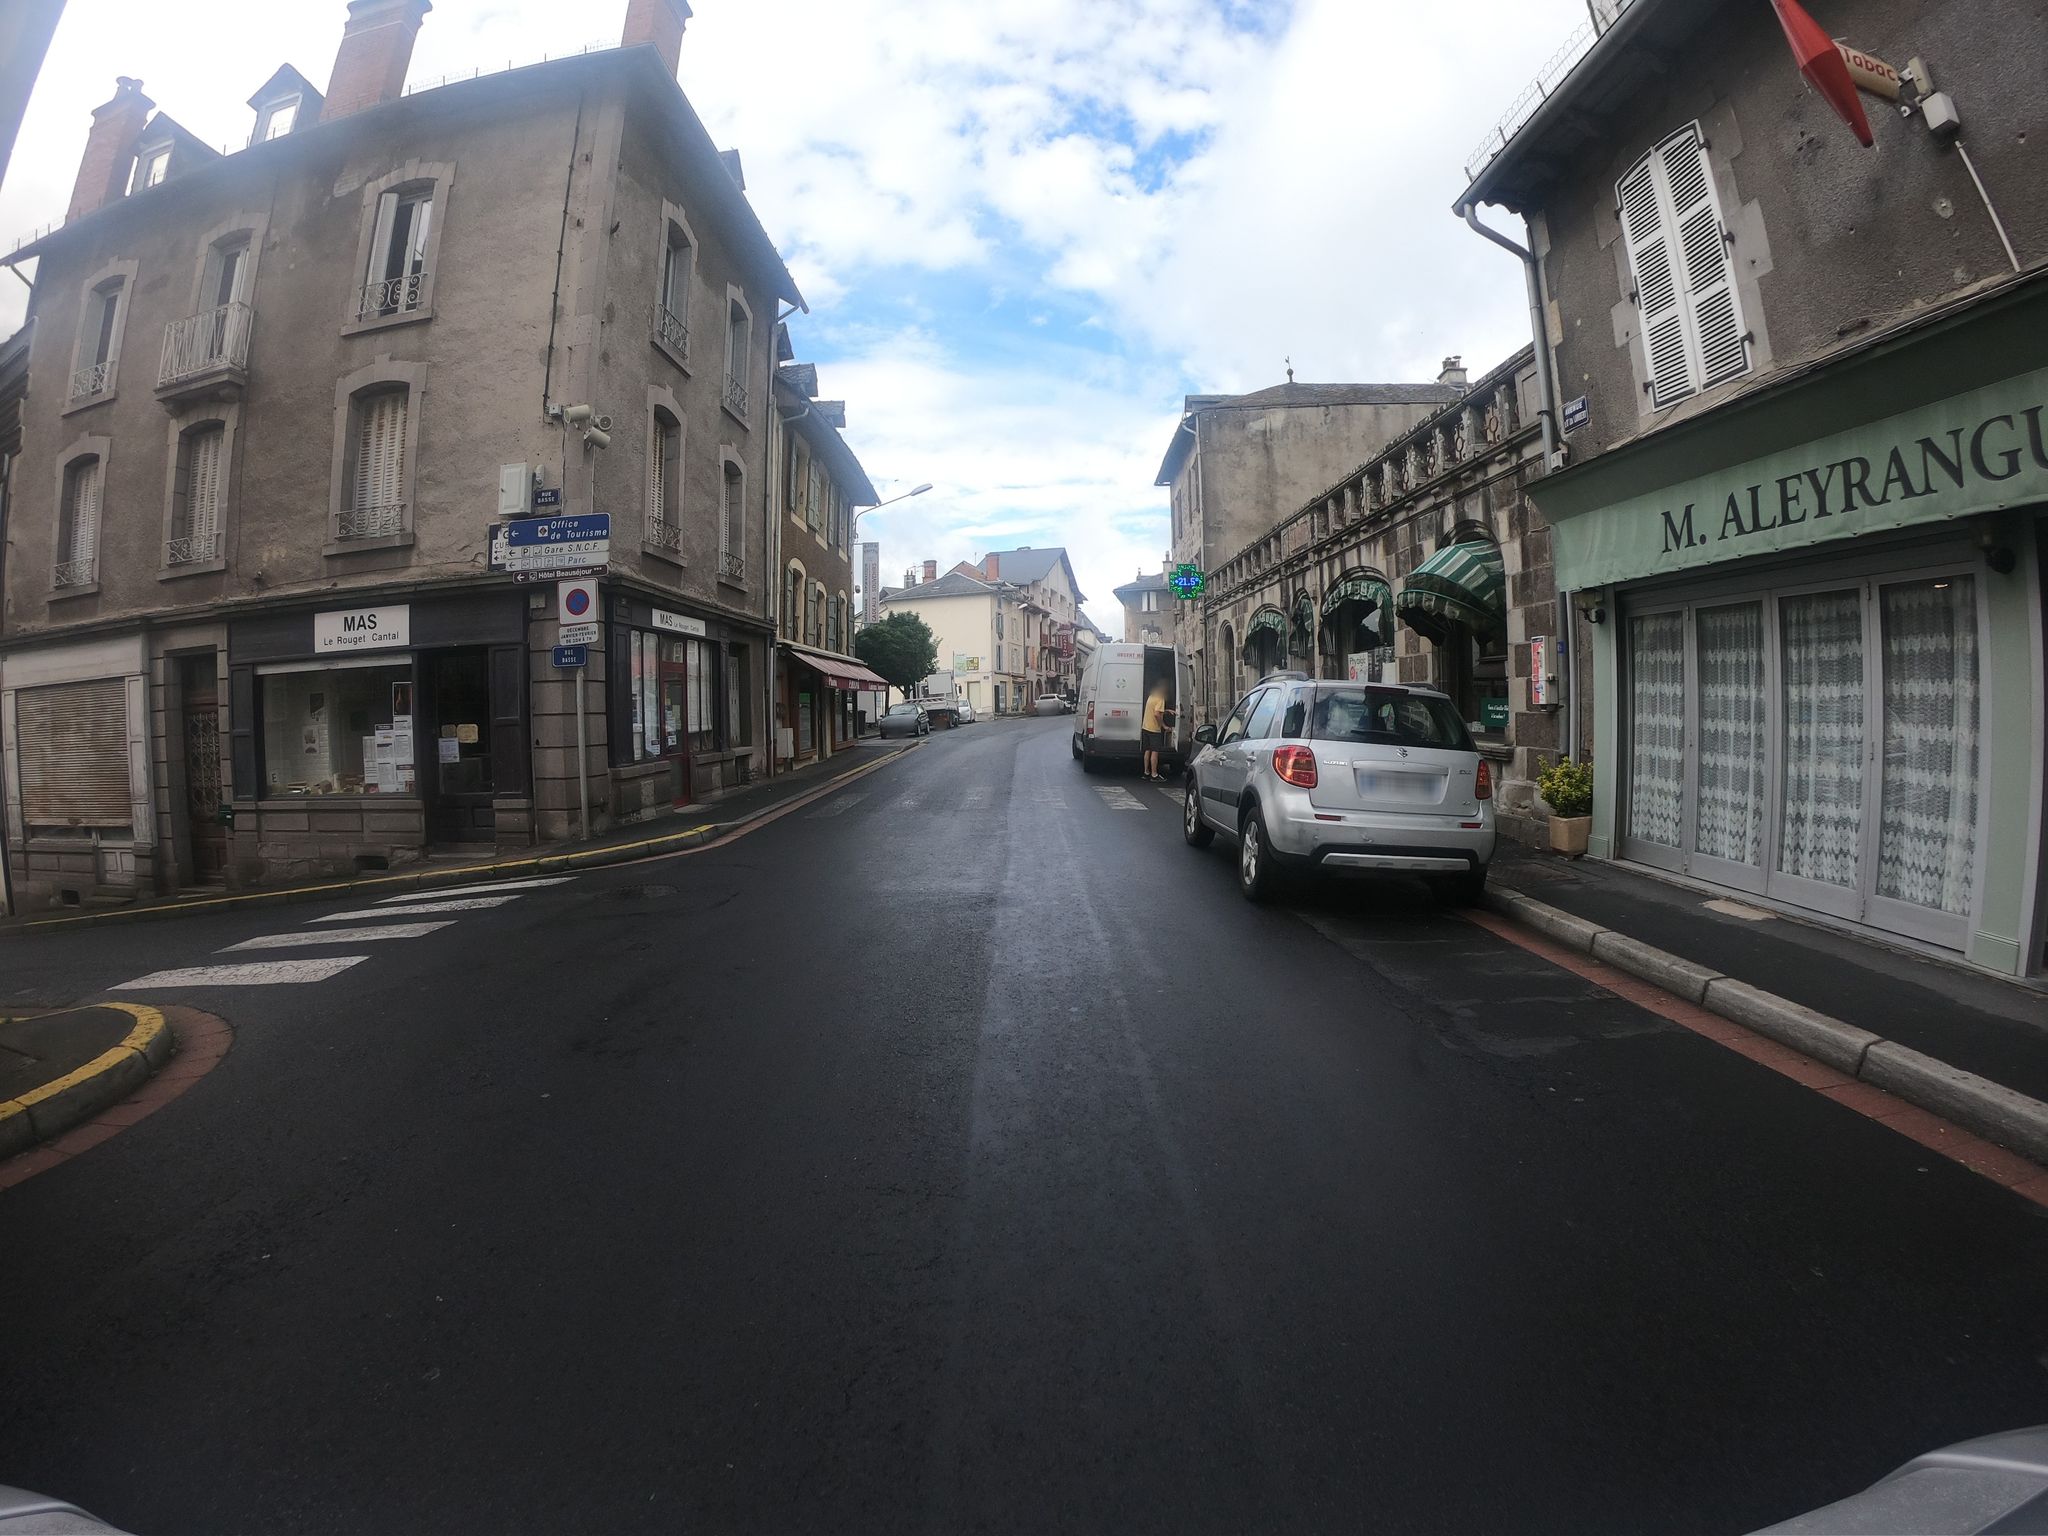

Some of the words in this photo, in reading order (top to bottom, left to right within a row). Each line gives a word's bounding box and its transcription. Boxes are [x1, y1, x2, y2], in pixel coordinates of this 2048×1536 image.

[550, 520, 578, 529] Office
[1661, 503, 1707, 553] M.
[550, 531, 561, 540] de
[567, 528, 607, 539] Tourisme
[544, 546, 564, 554] Gare
[568, 542, 600, 551] S.N.C.F.
[568, 555, 587, 563] Parc
[538, 570, 556, 579] Hôtel
[556, 568, 593, 578] Beauséjour
[343, 613, 378, 632] MAS
[660, 613, 673, 627] MAS
[323, 637, 334, 646] Le
[336, 634, 366, 646] Rouget
[371, 631, 400, 642] Cantal
